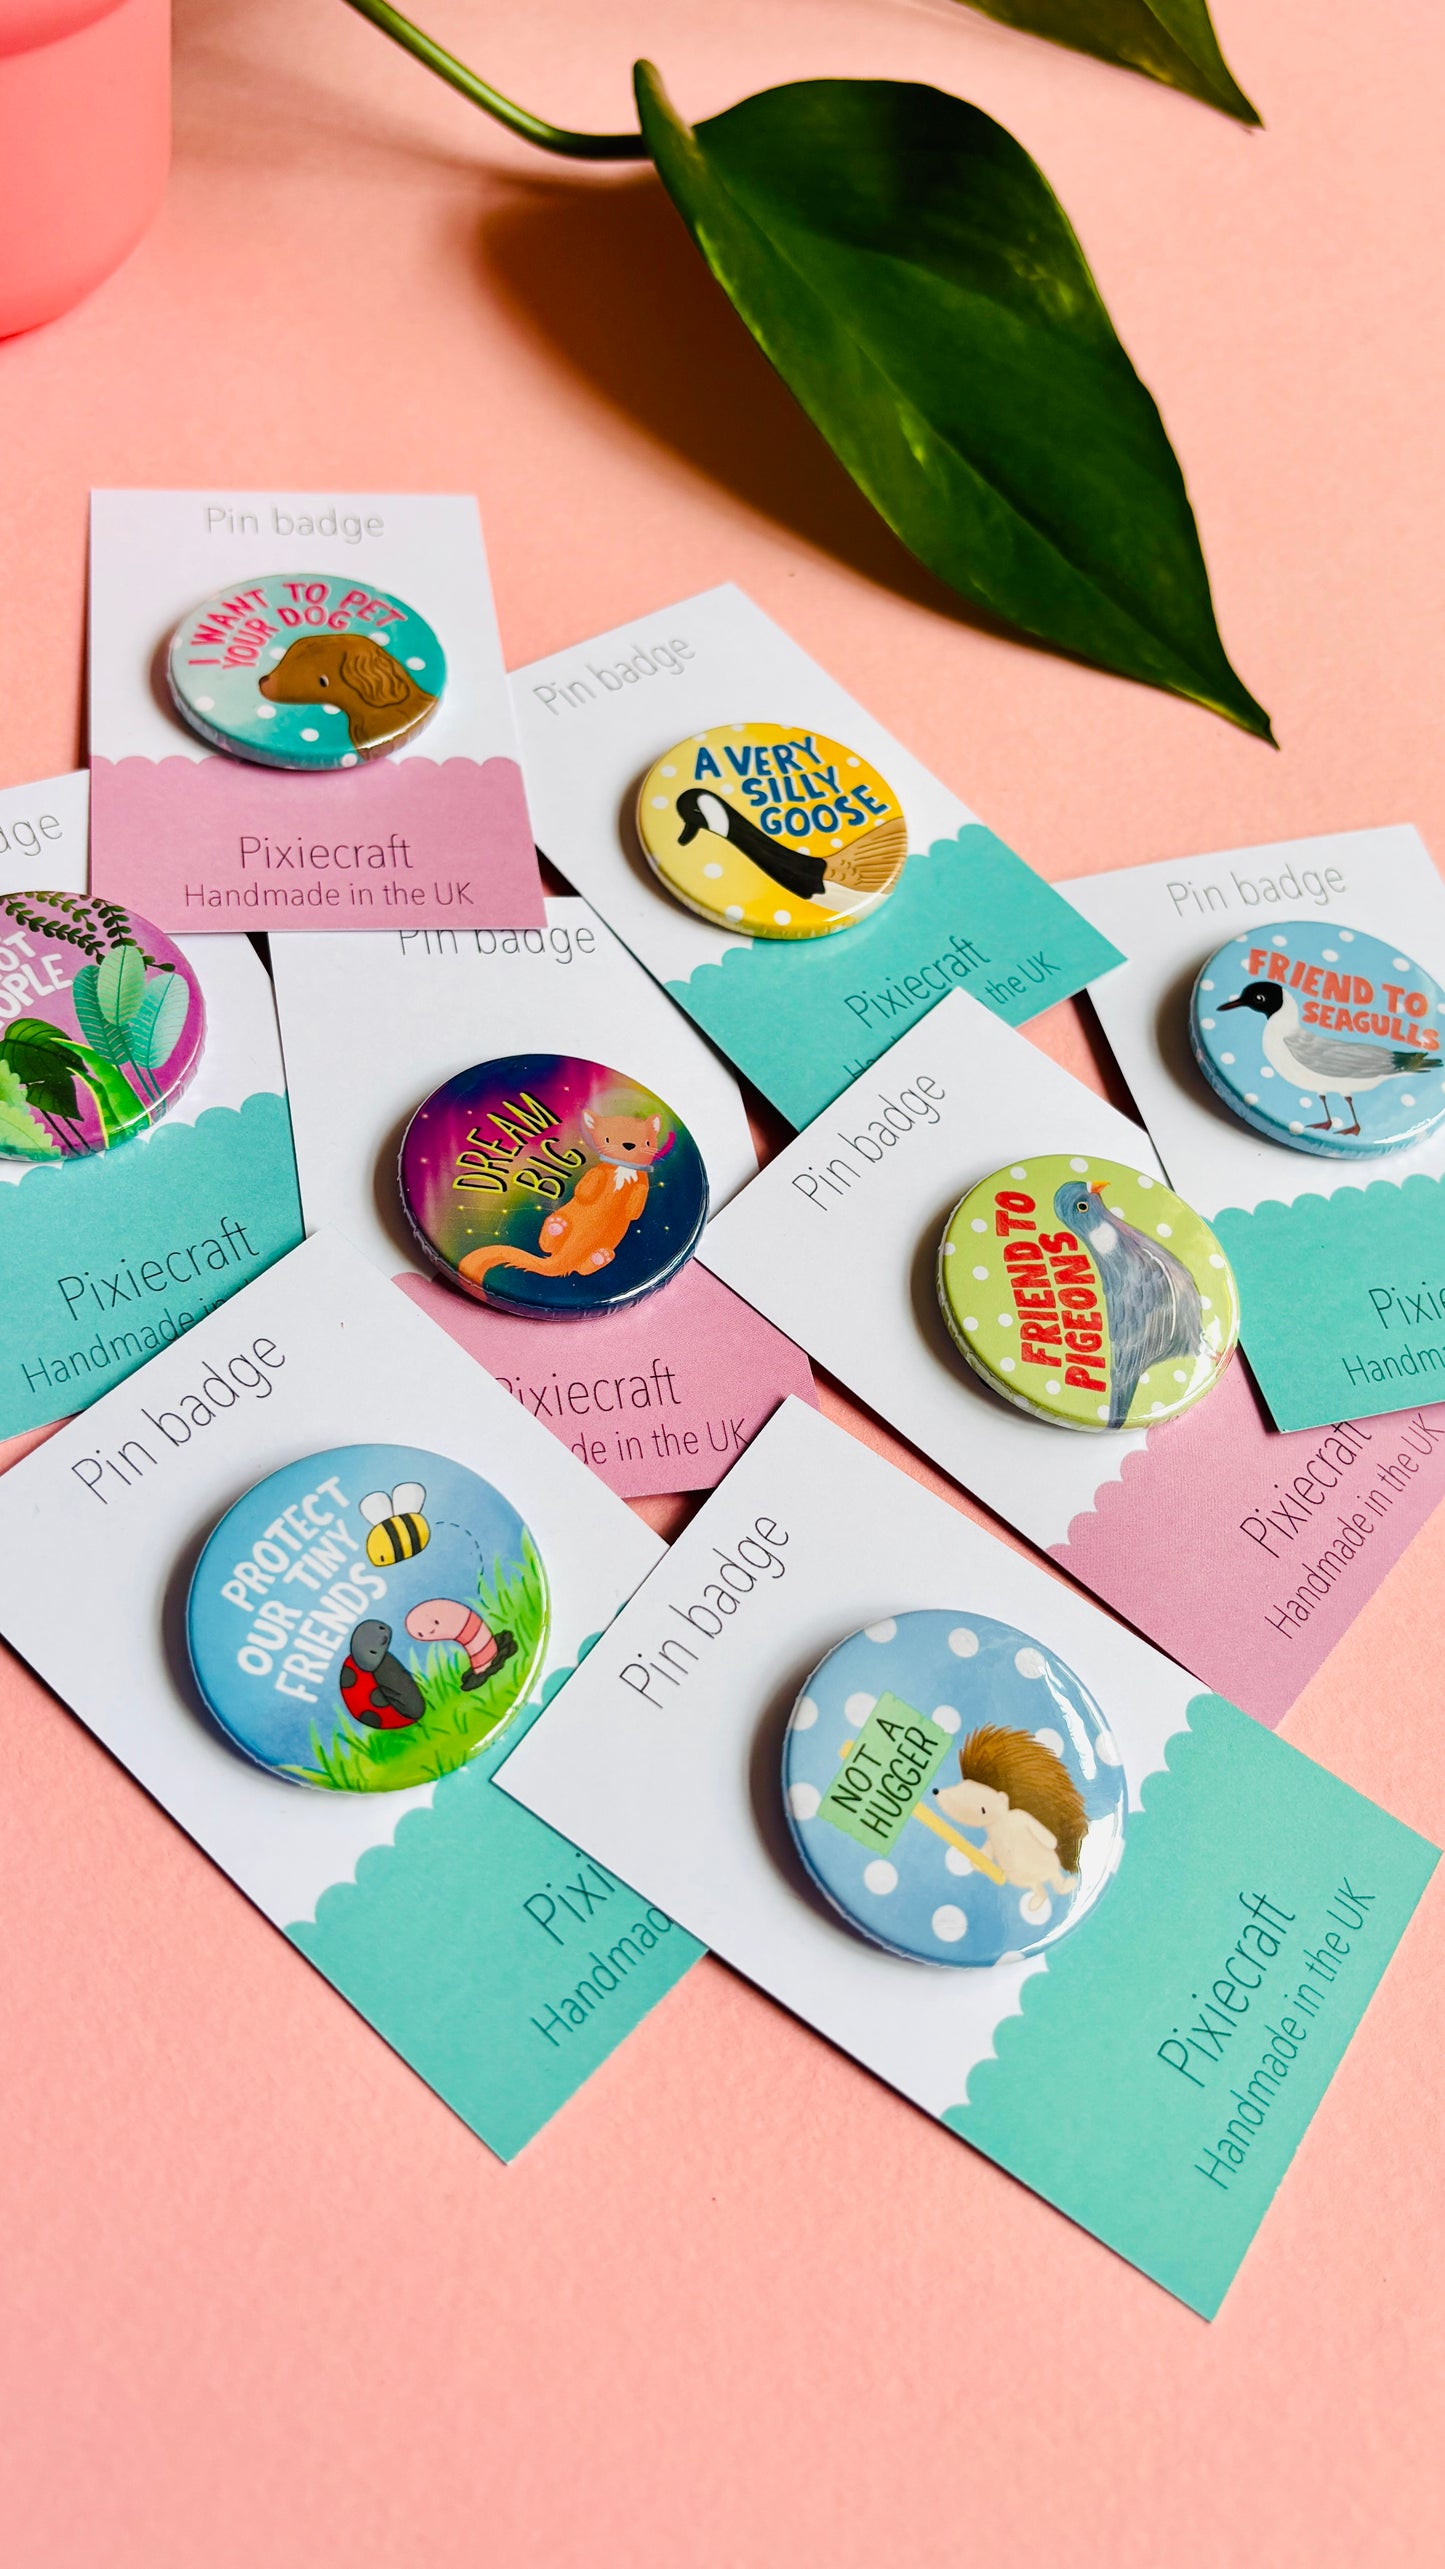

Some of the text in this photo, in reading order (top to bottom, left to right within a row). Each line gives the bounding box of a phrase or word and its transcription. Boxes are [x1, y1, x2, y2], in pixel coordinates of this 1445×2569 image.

[206, 506, 385, 544] Pin badge
[187, 582, 408, 666] I WANT TO PET
[221, 606, 351, 670] YOUR DOG
[532, 638, 696, 715] Pin badge
[694, 736, 824, 780] A VERY
[742, 766, 843, 807] SILLY
[240, 834, 413, 870] Pixiecraft
[760, 785, 888, 837] GOOSE
[185, 881, 474, 907] Handmade in the UK
[1166, 864, 1347, 917] Pin badge
[400, 929, 458, 955] Pin
[844, 936, 991, 1028] Pixiecraft
[984, 951, 1062, 1004] the UK
[1247, 948, 1428, 1018] FRIEND TO
[1301, 1002, 1440, 1051] SEAGULLS
[453, 1092, 563, 1195] DREAM
[512, 1137, 587, 1200] BIG
[792, 1159, 861, 1211] Pin
[837, 1075, 946, 1163] badge
[57, 1216, 260, 1321] Pixiecraft
[995, 1190, 1063, 1368] FRIEND TO
[21, 1308, 195, 1393] Handmade
[1038, 1231, 1107, 1393] PIGEONS
[1341, 1344, 1445, 1386] Handm
[71, 1338, 286, 1505] Pin badge
[615, 1431, 644, 1462] in
[651, 1423, 699, 1458] the
[706, 1418, 749, 1452] UK
[1239, 1422, 1372, 1558] Pixiecraft
[1264, 1413, 1444, 1640] Handmade in the UK
[221, 1476, 350, 1612] PROTECT
[237, 1519, 359, 1676] OUR TINY
[275, 1562, 387, 1704] FRIENDS
[619, 1516, 789, 1709] Pin badge
[830, 1717, 905, 1814] NOT A
[859, 1726, 939, 1838] HUGGER
[1157, 1891, 1296, 2088] Pixiecraft
[1194, 1876, 1376, 2190] Handmade in the UK
